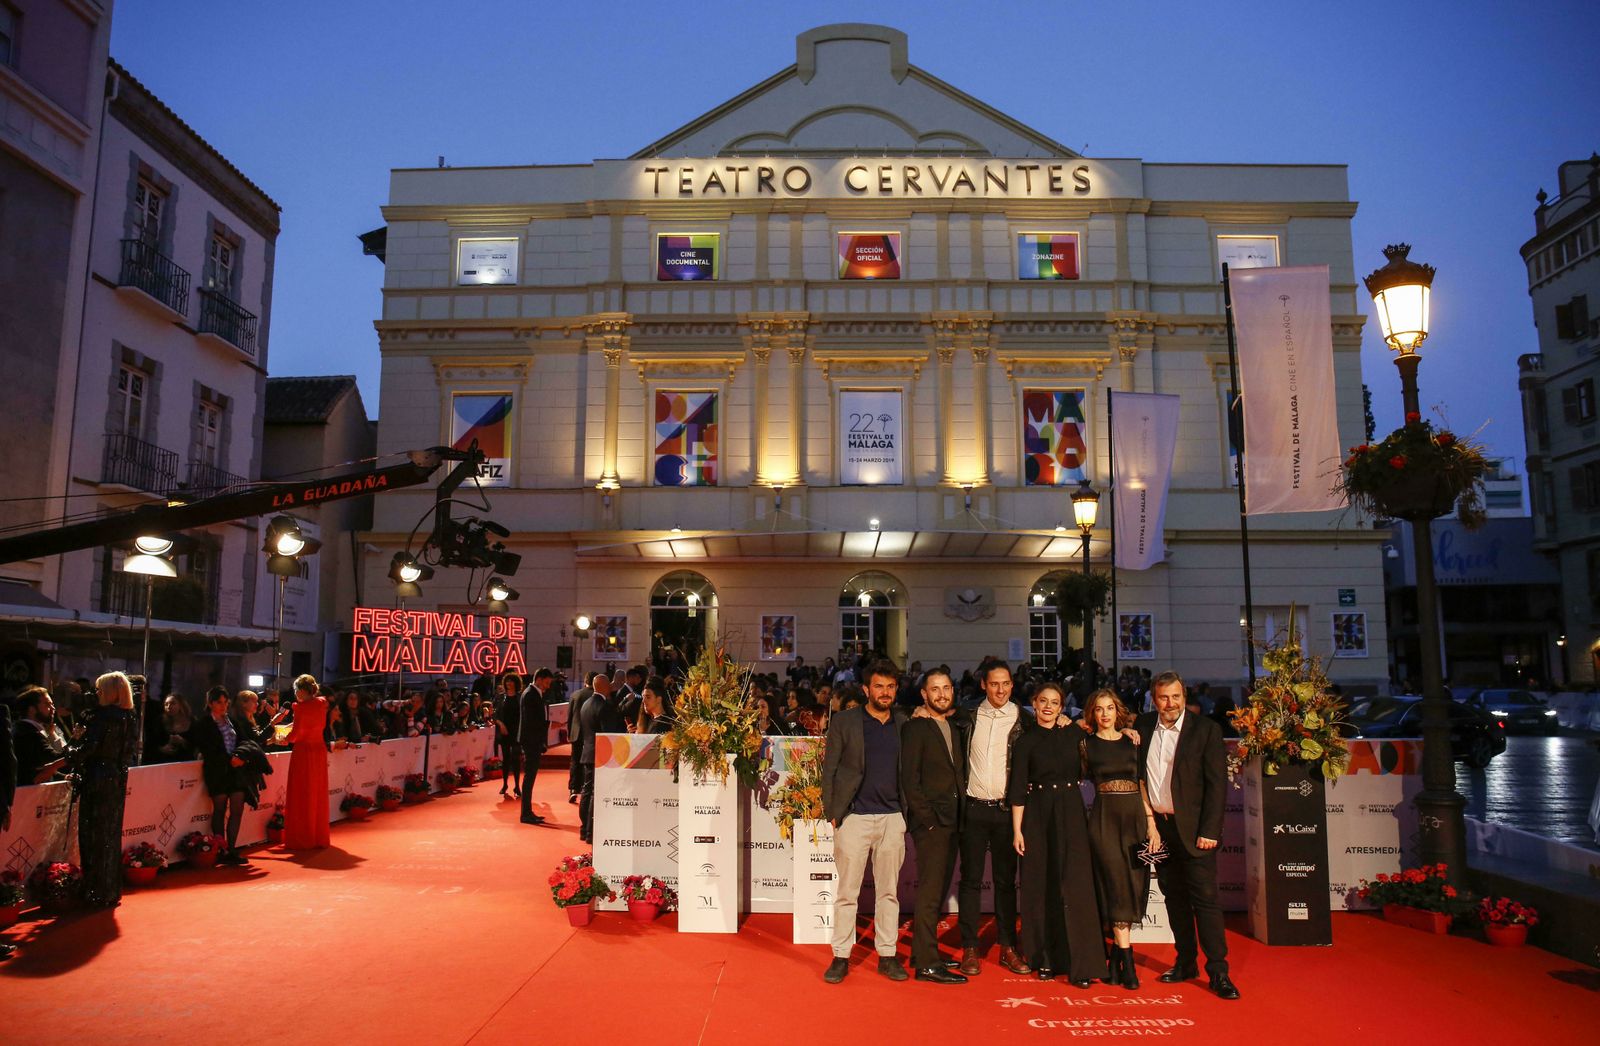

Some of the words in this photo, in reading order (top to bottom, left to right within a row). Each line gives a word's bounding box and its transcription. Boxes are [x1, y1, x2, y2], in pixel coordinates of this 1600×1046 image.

[645, 165, 812, 194] TEATRO
[844, 164, 1092, 194] CERVANTES
[855, 245, 884, 254] SECCIÓN
[1288, 354, 1295, 366] EN
[1288, 368, 1297, 392] CINE
[849, 413, 875, 432] 22
[1293, 432, 1300, 445] DE
[1293, 447, 1301, 489] FESTIVAL
[272, 493, 295, 507] LA
[303, 474, 388, 501] GUADAÑA
[1140, 514, 1146, 523] DE
[354, 607, 482, 639] FESTIVAL
[489, 616, 525, 640] DE
[352, 631, 528, 675] MÁLAGA
[602, 839, 662, 848] ATRESMEDIA
[744, 842, 785, 850] ESMEDIA
[1345, 846, 1403, 855] ATRESMEDIA
[1278, 863, 1315, 873] Cruzcampo
[1028, 1017, 1195, 1029] Cruzcampo
[1070, 1028, 1172, 1037] ESPECIAL
